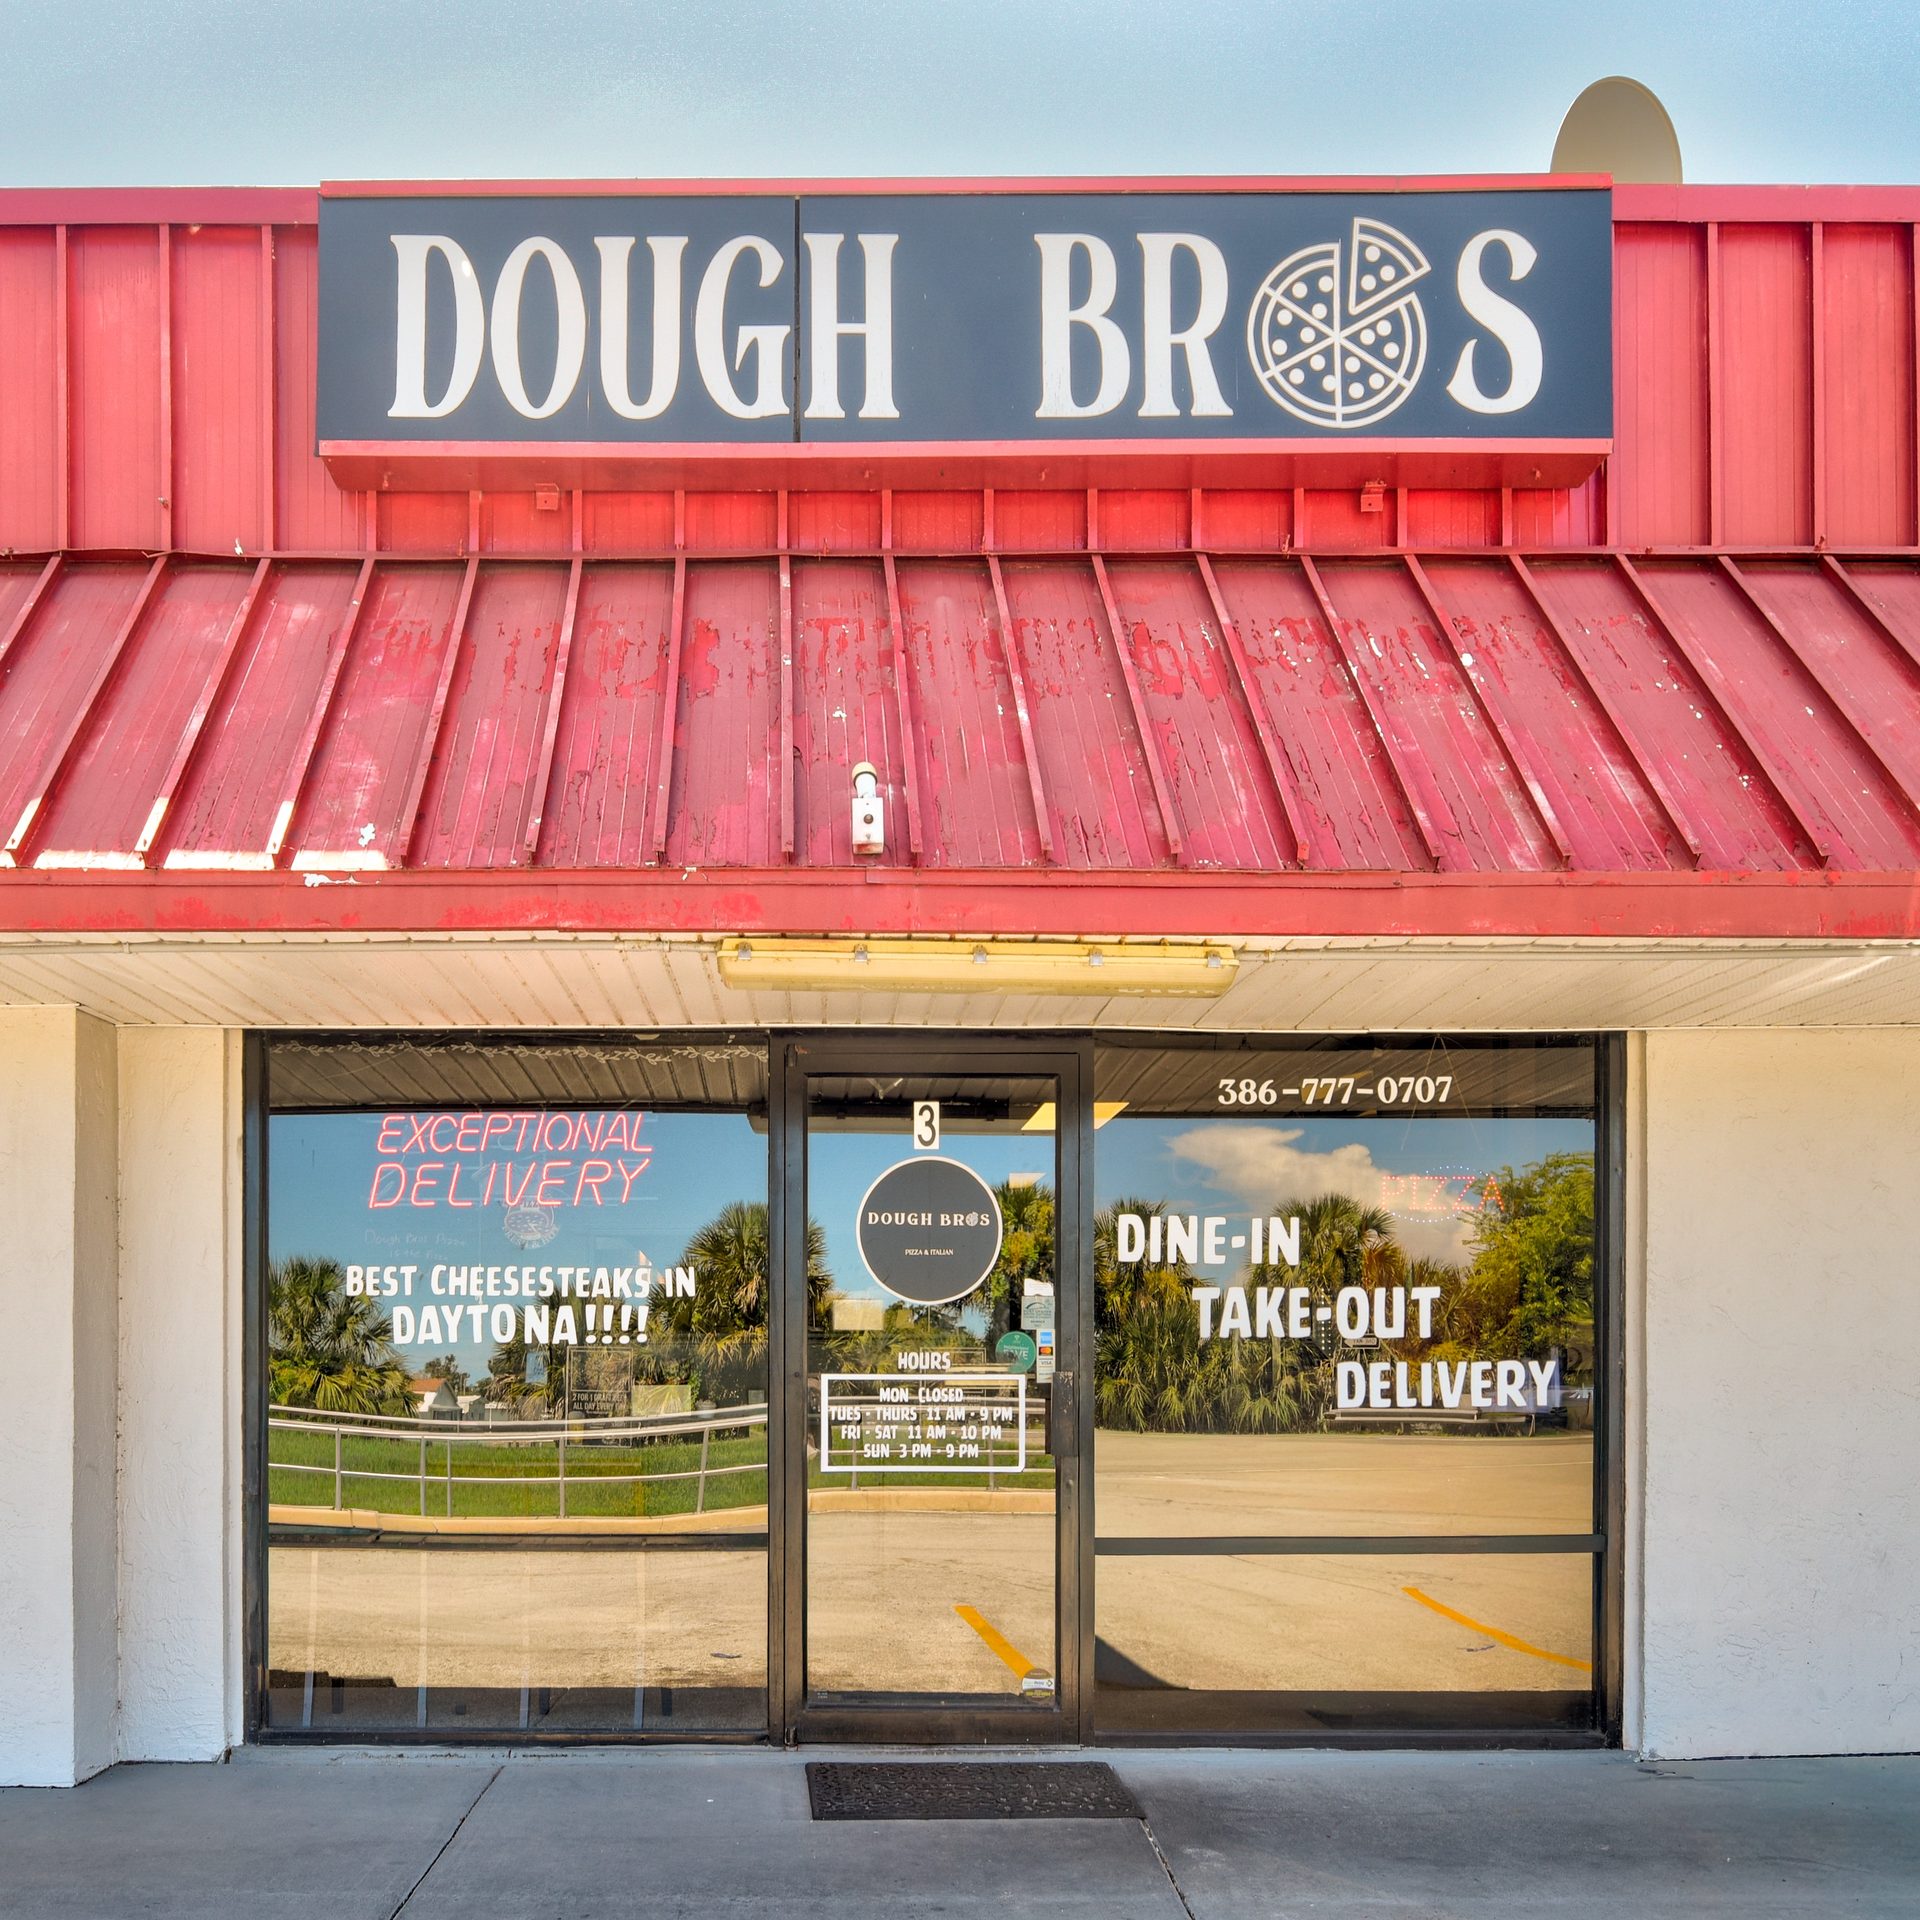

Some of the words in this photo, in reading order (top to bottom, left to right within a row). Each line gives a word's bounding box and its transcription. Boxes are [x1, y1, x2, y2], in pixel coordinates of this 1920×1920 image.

[387, 232, 900, 420] DOUGH
[1034, 216, 1544, 429] BROS
[1217, 1075, 1453, 1105] 386-777-0707
[377, 1112, 654, 1153] EXCEPTIONAL
[917, 1104, 936, 1147] 3
[368, 1157, 650, 1208] DELIVERY
[1381, 1174, 1505, 1212] PIZZA
[868, 1211, 932, 1226] DOUGH
[940, 1211, 990, 1227] BROS
[905, 1248, 923, 1256] PIZZA
[924, 1248, 930, 1256] &
[930, 1248, 954, 1256] ITALIAN
[1117, 1214, 1300, 1265] DINE-IN
[346, 1264, 417, 1297] BEST
[430, 1263, 650, 1299] CHEESESTEAKS
[665, 1265, 696, 1298] IN
[393, 1303, 649, 1345] DAYTONA!!!!
[1192, 1286, 1441, 1339] TAKE-OUT
[897, 1351, 950, 1370] HOURS
[879, 1387, 909, 1403] MON
[918, 1387, 964, 1403] CLOSED
[1337, 1360, 1556, 1409] DELIVERY
[829, 1406, 861, 1421] TUES
[876, 1406, 917, 1421] THURS
[926, 1406, 941, 1421] 11
[945, 1406, 965, 1421] AM
[980, 1406, 989, 1421] 9
[993, 1406, 1013, 1421] PM
[841, 1425, 860, 1440] FRI
[875, 1425, 898, 1440] SAT
[907, 1425, 921, 1440] 11
[926, 1425, 946, 1440] AM
[961, 1425, 977, 1440] 10
[982, 1425, 1001, 1440] PM
[863, 1443, 890, 1458] SUN
[899, 1443, 907, 1458] 3
[912, 1443, 931, 1458] PM
[946, 1443, 954, 1458] 9
[959, 1443, 979, 1458] PM
